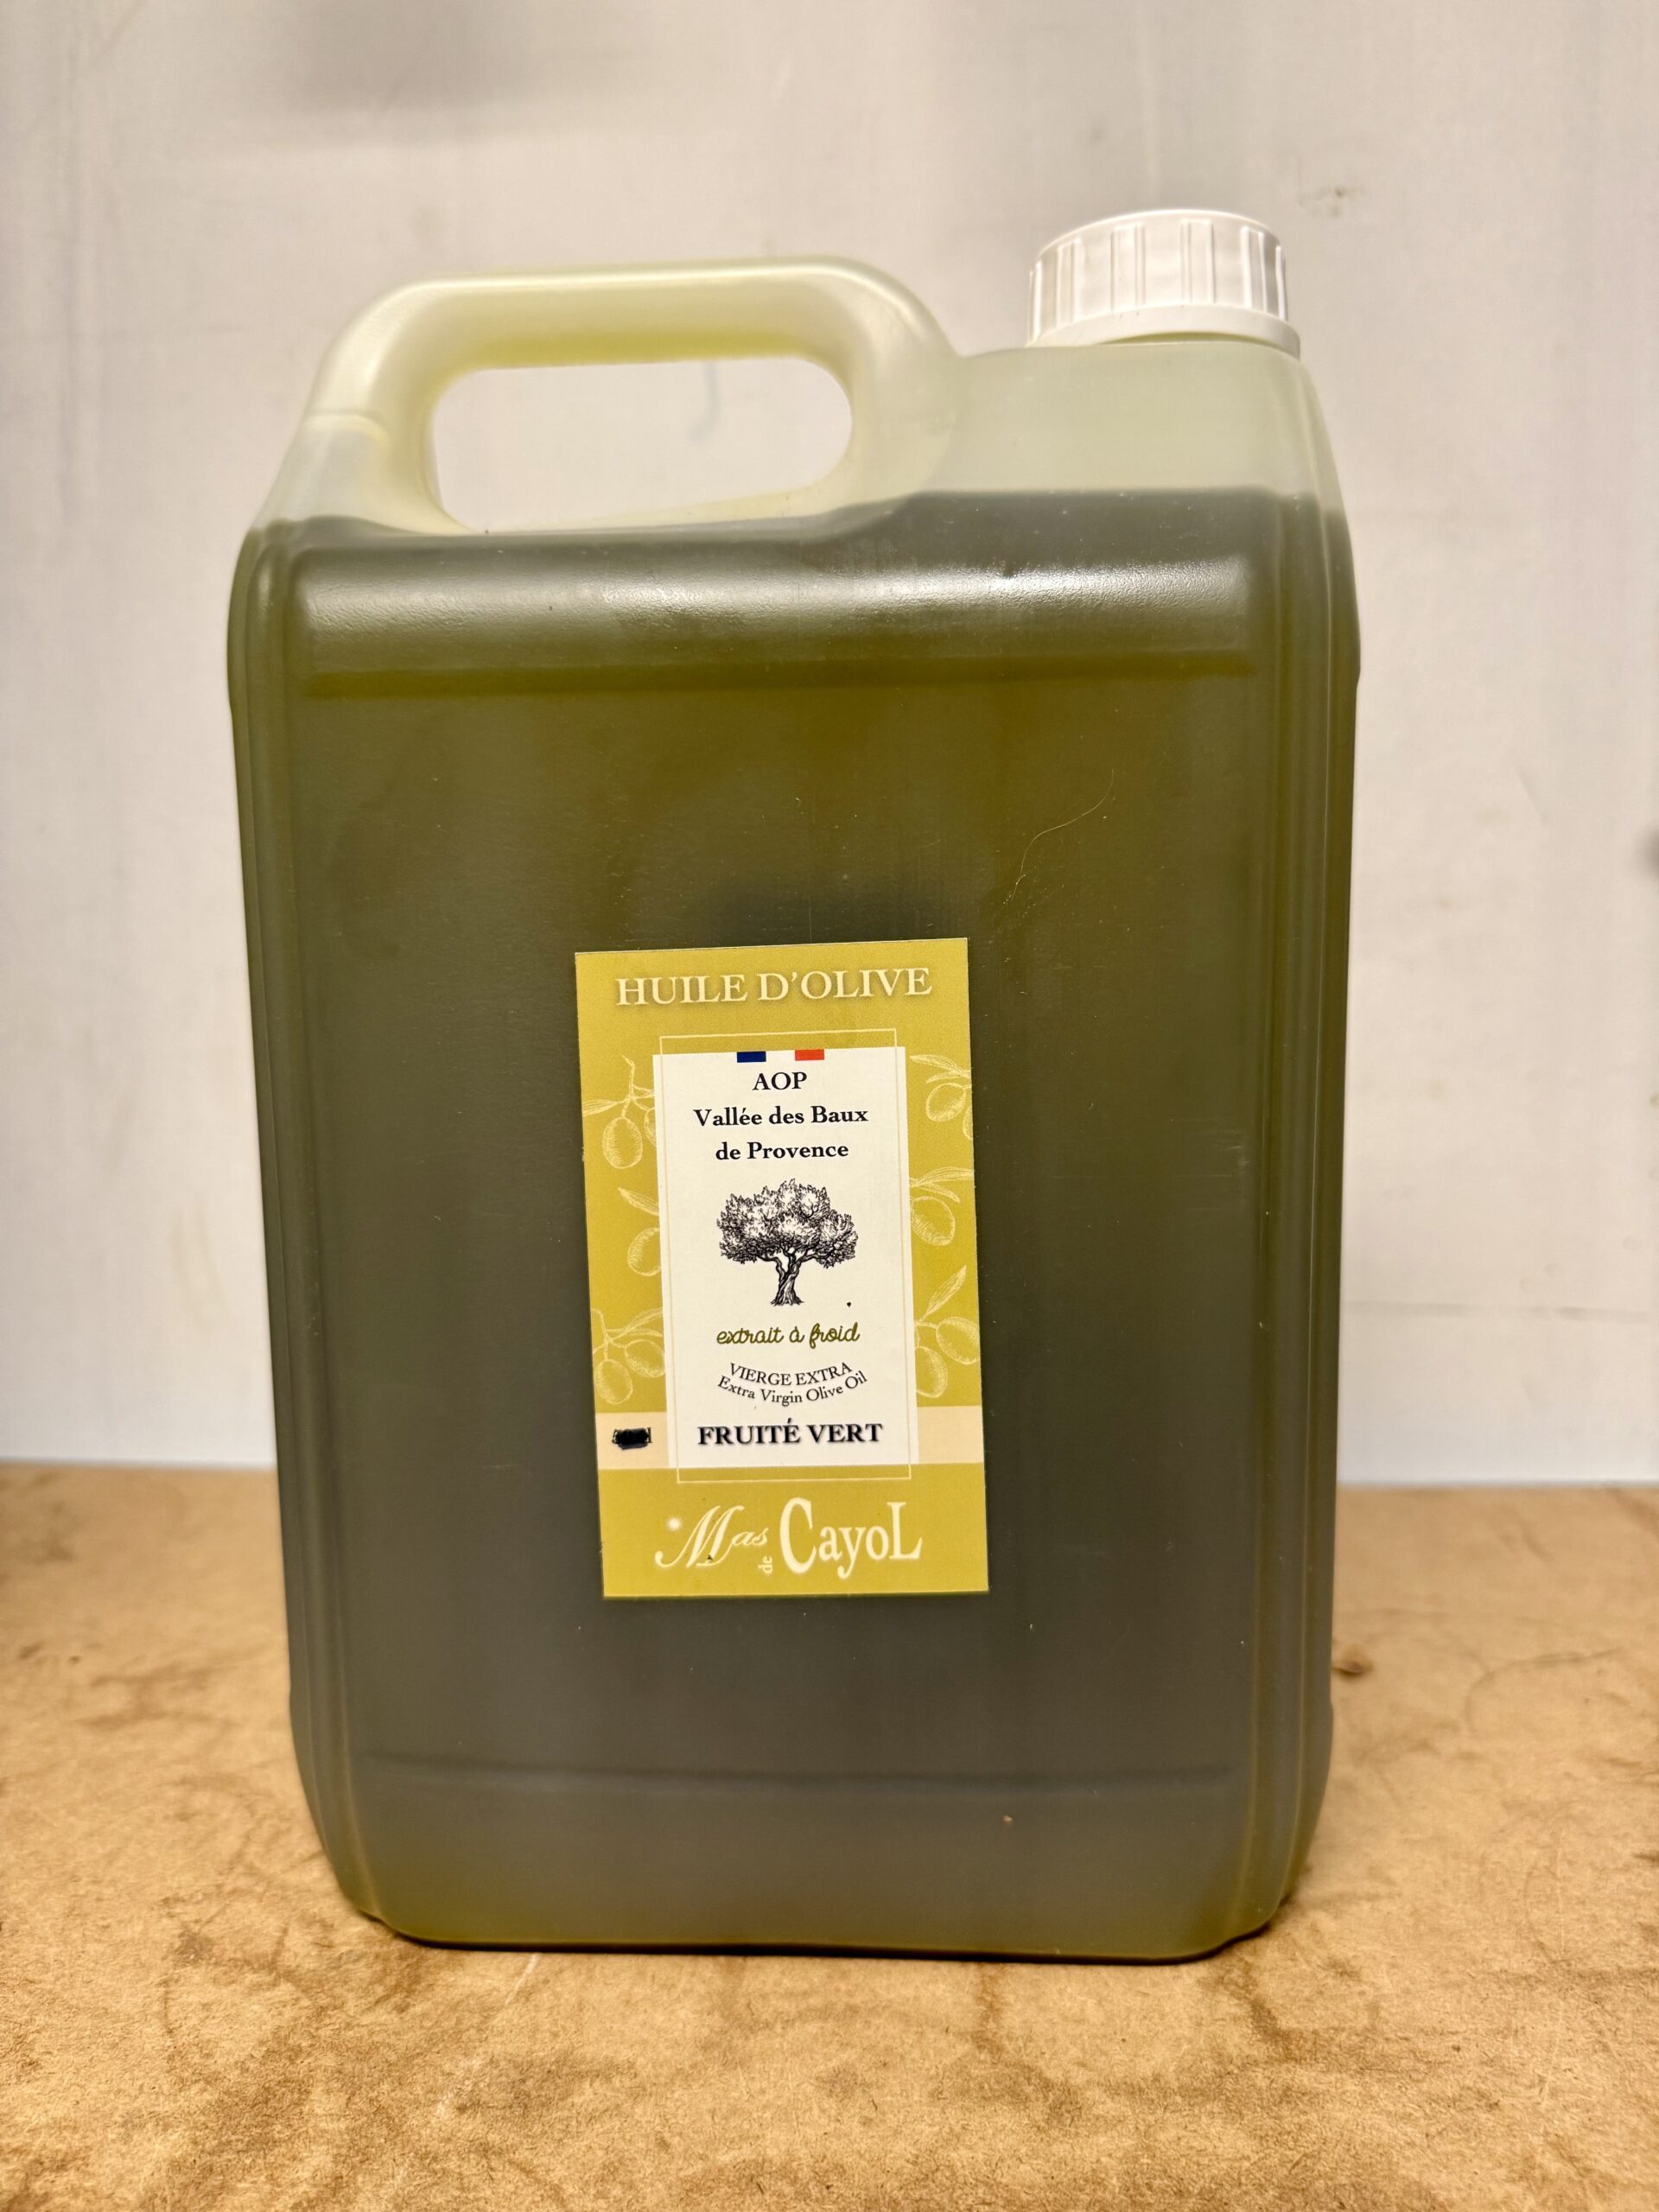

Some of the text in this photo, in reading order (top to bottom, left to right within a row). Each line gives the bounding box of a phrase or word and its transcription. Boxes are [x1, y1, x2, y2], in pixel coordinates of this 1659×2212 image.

[616, 974, 747, 1006] HUILE
[752, 1072, 807, 1090] AOP
[693, 1105, 868, 1127] Vallée des Baux
[715, 1141, 849, 1161] de Provence
[716, 1322, 860, 1349] extrait à froid
[729, 1362, 853, 1386] VIERGE EXTRA
[717, 1370, 868, 1407] Extra Virgin Olive Oil
[697, 1418, 884, 1446] FRUITÉ VERT
[654, 1504, 769, 1568] Mas
[758, 1556, 772, 1574] de
